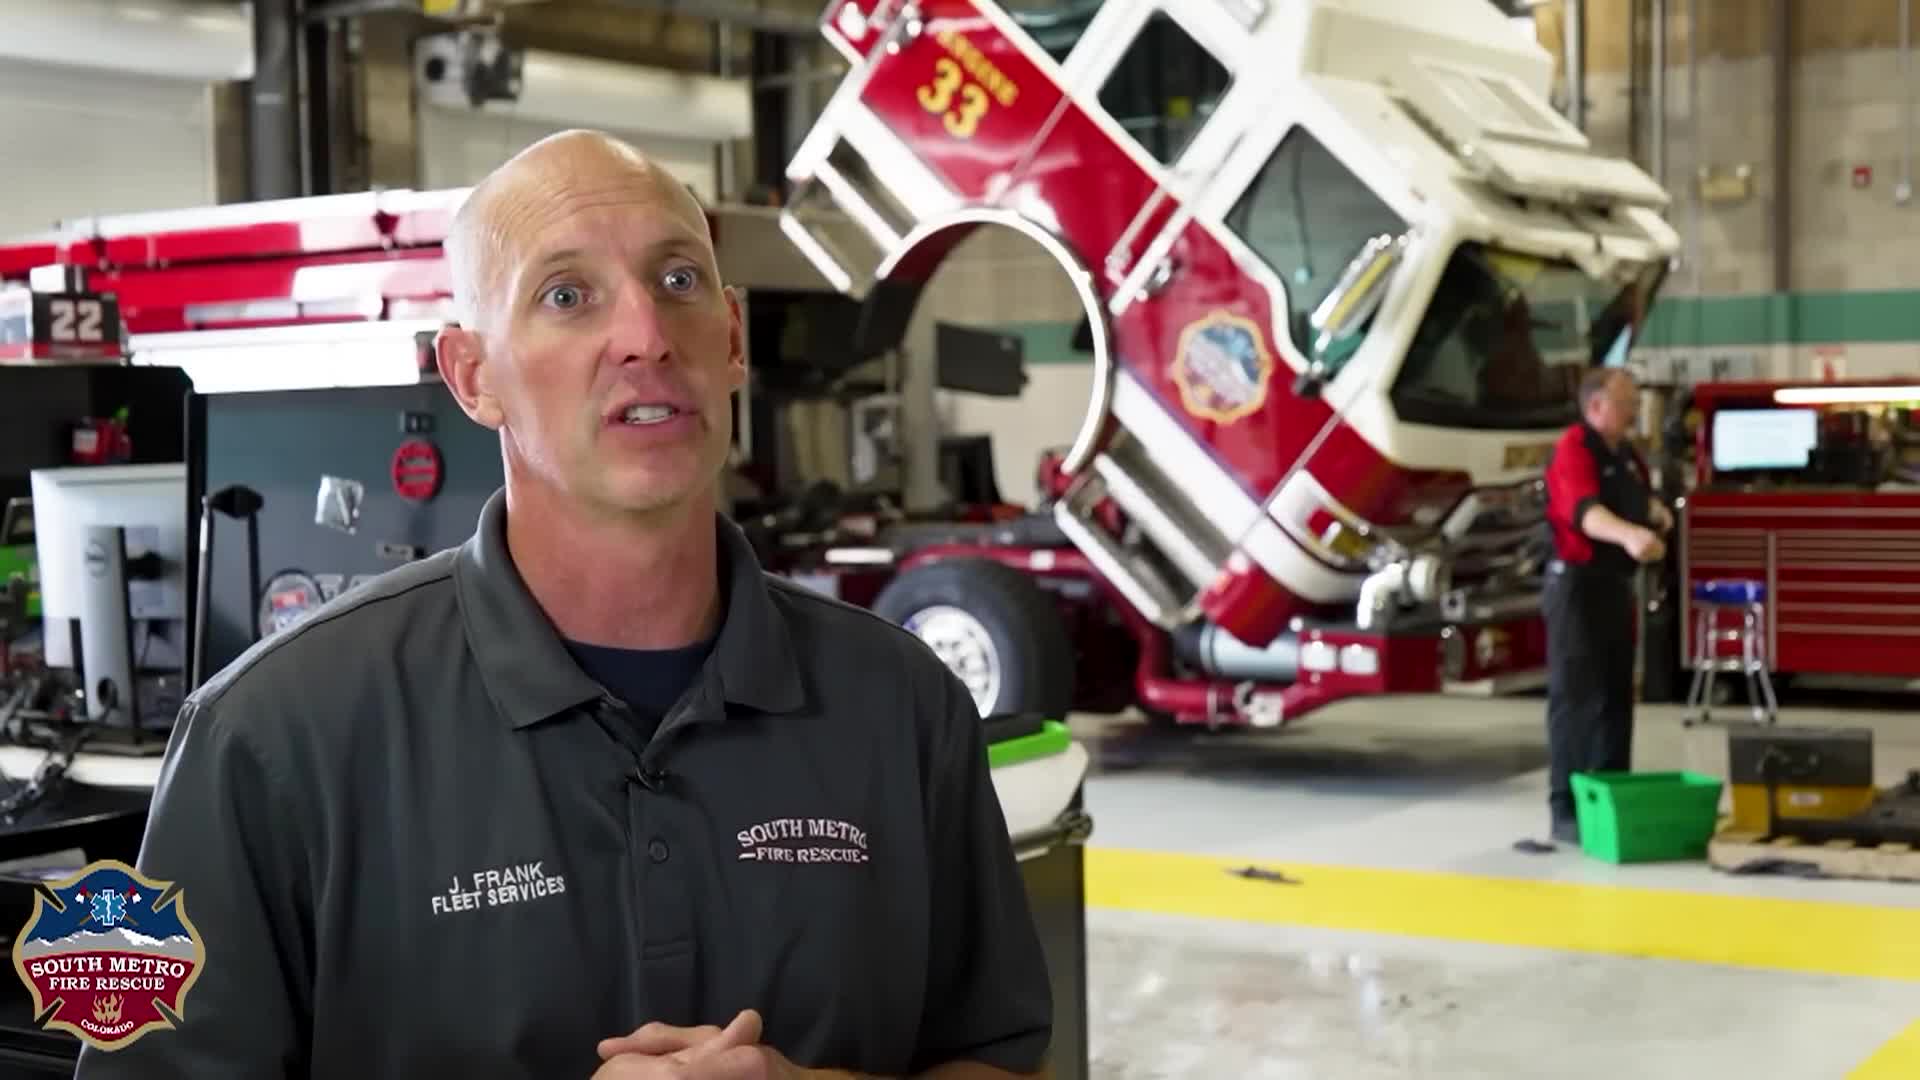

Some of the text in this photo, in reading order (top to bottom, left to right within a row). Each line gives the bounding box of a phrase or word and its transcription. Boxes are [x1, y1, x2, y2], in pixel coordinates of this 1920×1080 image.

[916, 57, 989, 138] 33
[50, 301, 103, 340] 22
[737, 818, 803, 847] SOUTH
[756, 847, 861, 862] FIRE RESCUE
[431, 876, 565, 915] FLEET SERVICES
[449, 861, 544, 894] J. FRANK
